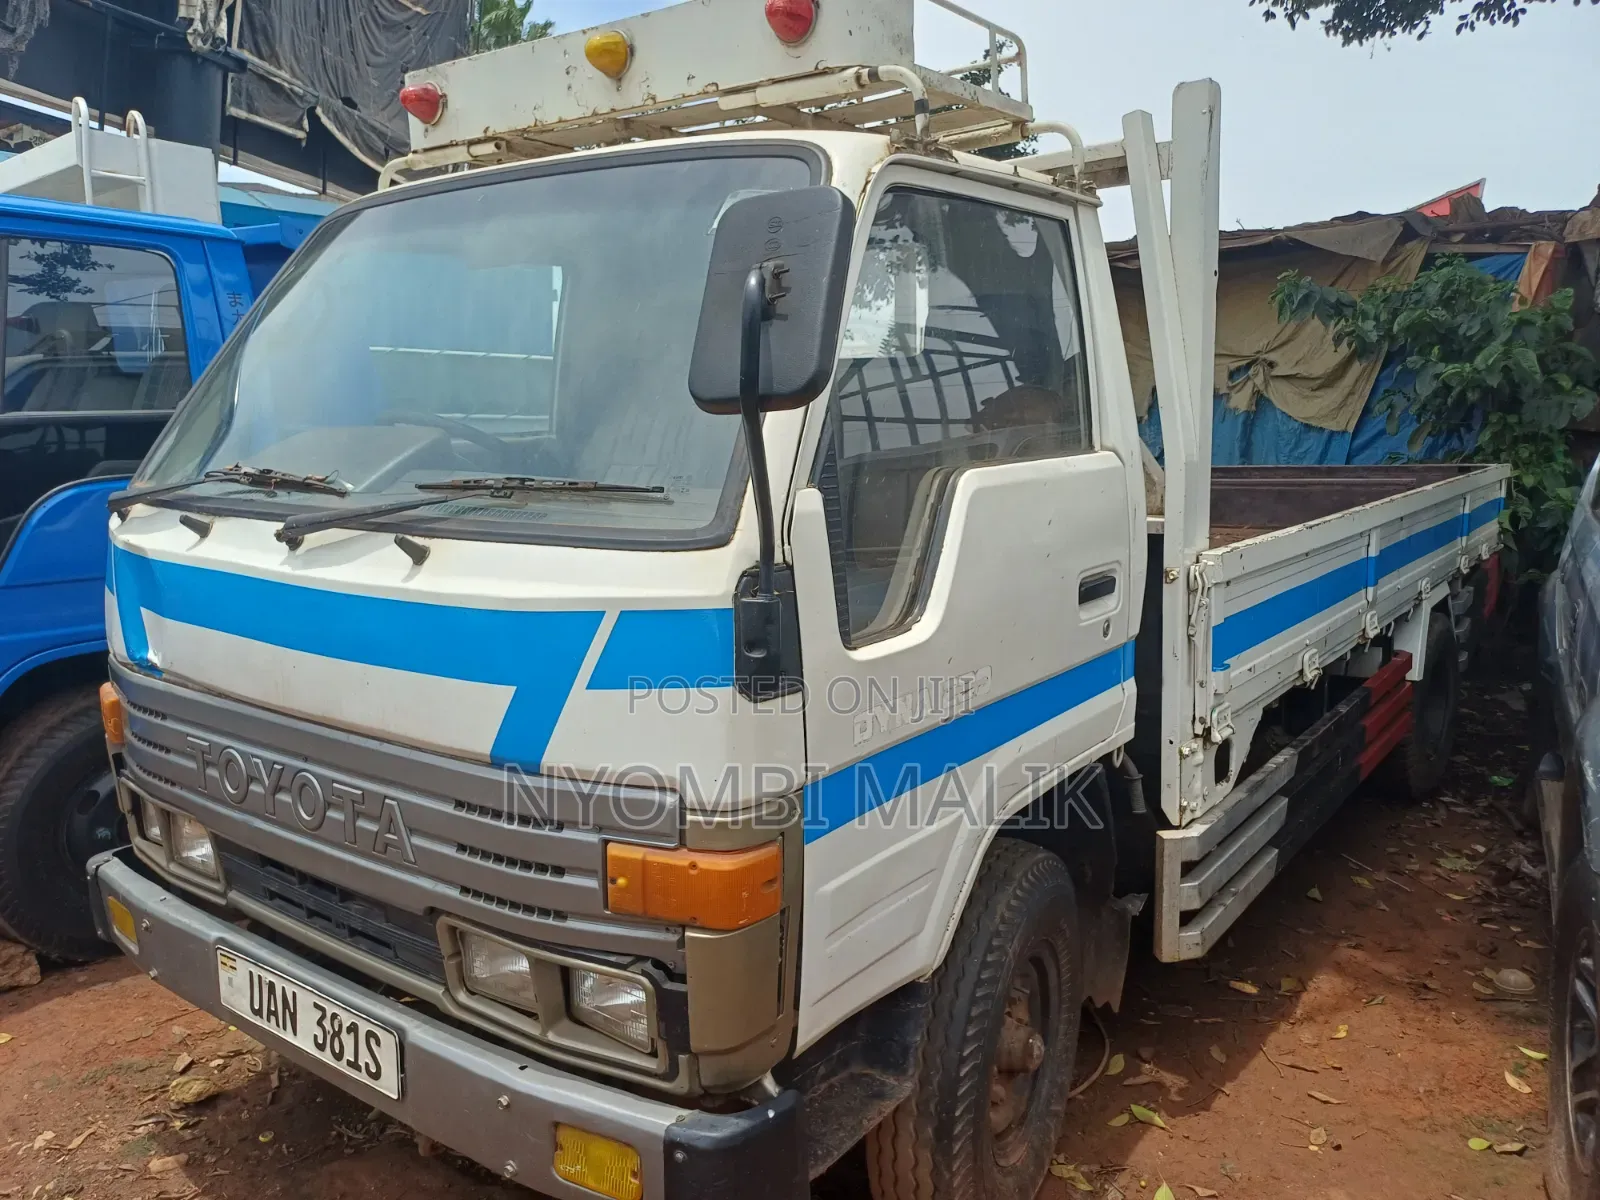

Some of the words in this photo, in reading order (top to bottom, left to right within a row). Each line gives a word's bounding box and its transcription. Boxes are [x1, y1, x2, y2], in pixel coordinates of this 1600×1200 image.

[185, 735, 419, 868] TOYOTA
[248, 969, 298, 1037] UAN
[312, 1000, 383, 1082] 381S
